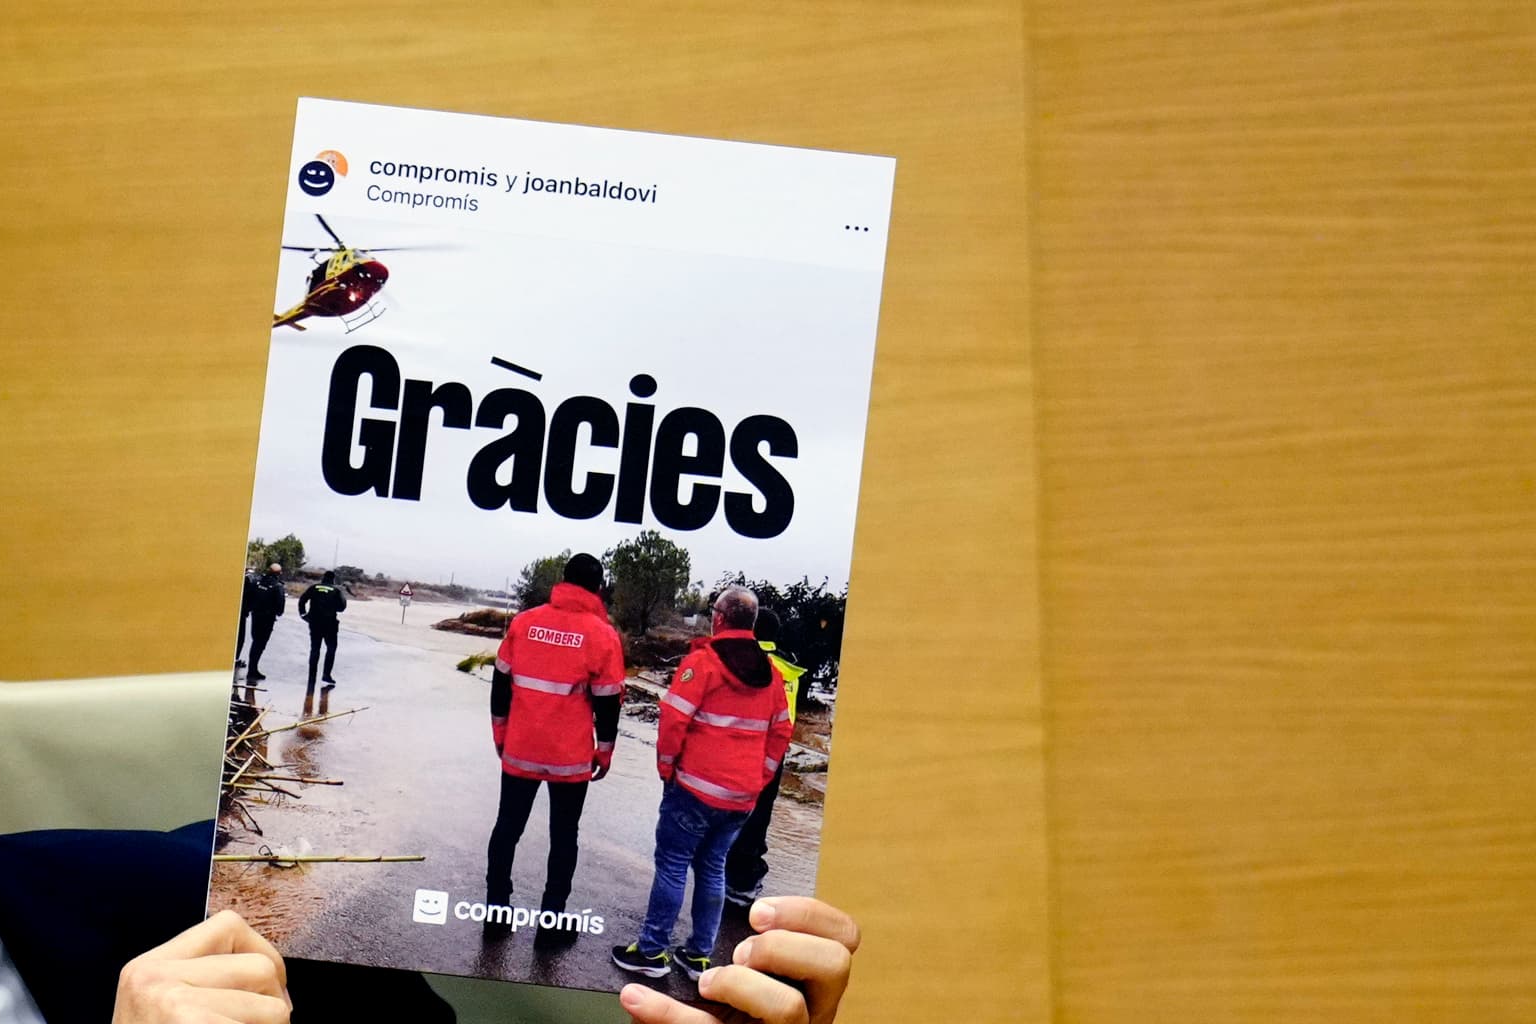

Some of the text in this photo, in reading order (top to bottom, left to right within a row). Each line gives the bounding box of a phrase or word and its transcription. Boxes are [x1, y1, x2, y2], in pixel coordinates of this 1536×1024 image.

[366, 184, 480, 212] Compromís
[369, 160, 658, 204] compromis y joanbaldovi
[321, 343, 799, 540] Gràcies
[529, 627, 582, 646] BOMBERS
[454, 901, 605, 935] compromís
